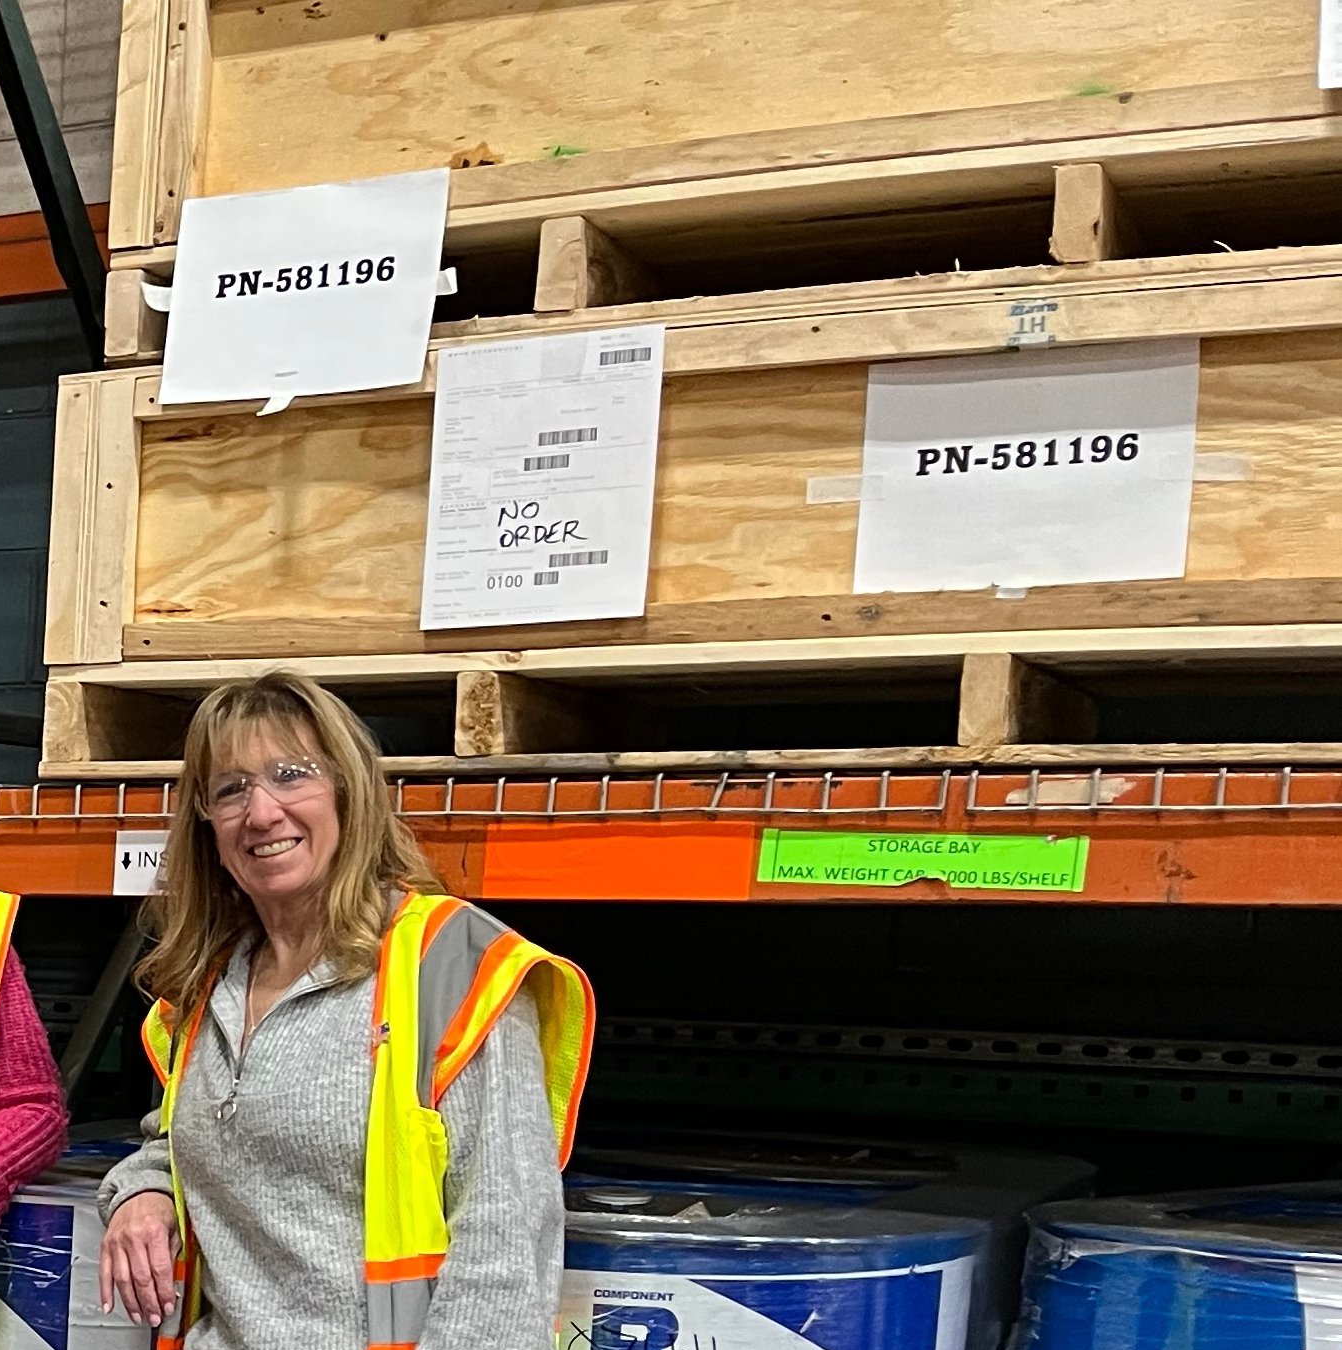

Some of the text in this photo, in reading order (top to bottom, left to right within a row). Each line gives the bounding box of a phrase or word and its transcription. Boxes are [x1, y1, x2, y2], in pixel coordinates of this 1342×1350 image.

[216, 256, 395, 298] PN-581196
[916, 433, 1139, 476] PN-581196
[498, 500, 540, 527] NO
[499, 519, 588, 548] ORDER
[487, 574, 523, 589] 0100
[867, 838, 982, 855] STORAGE BAY
[824, 866, 890, 882] WEIGHT
[982, 870, 1070, 887] LBS/SHELF
[593, 1288, 675, 1302] COMPONENT
